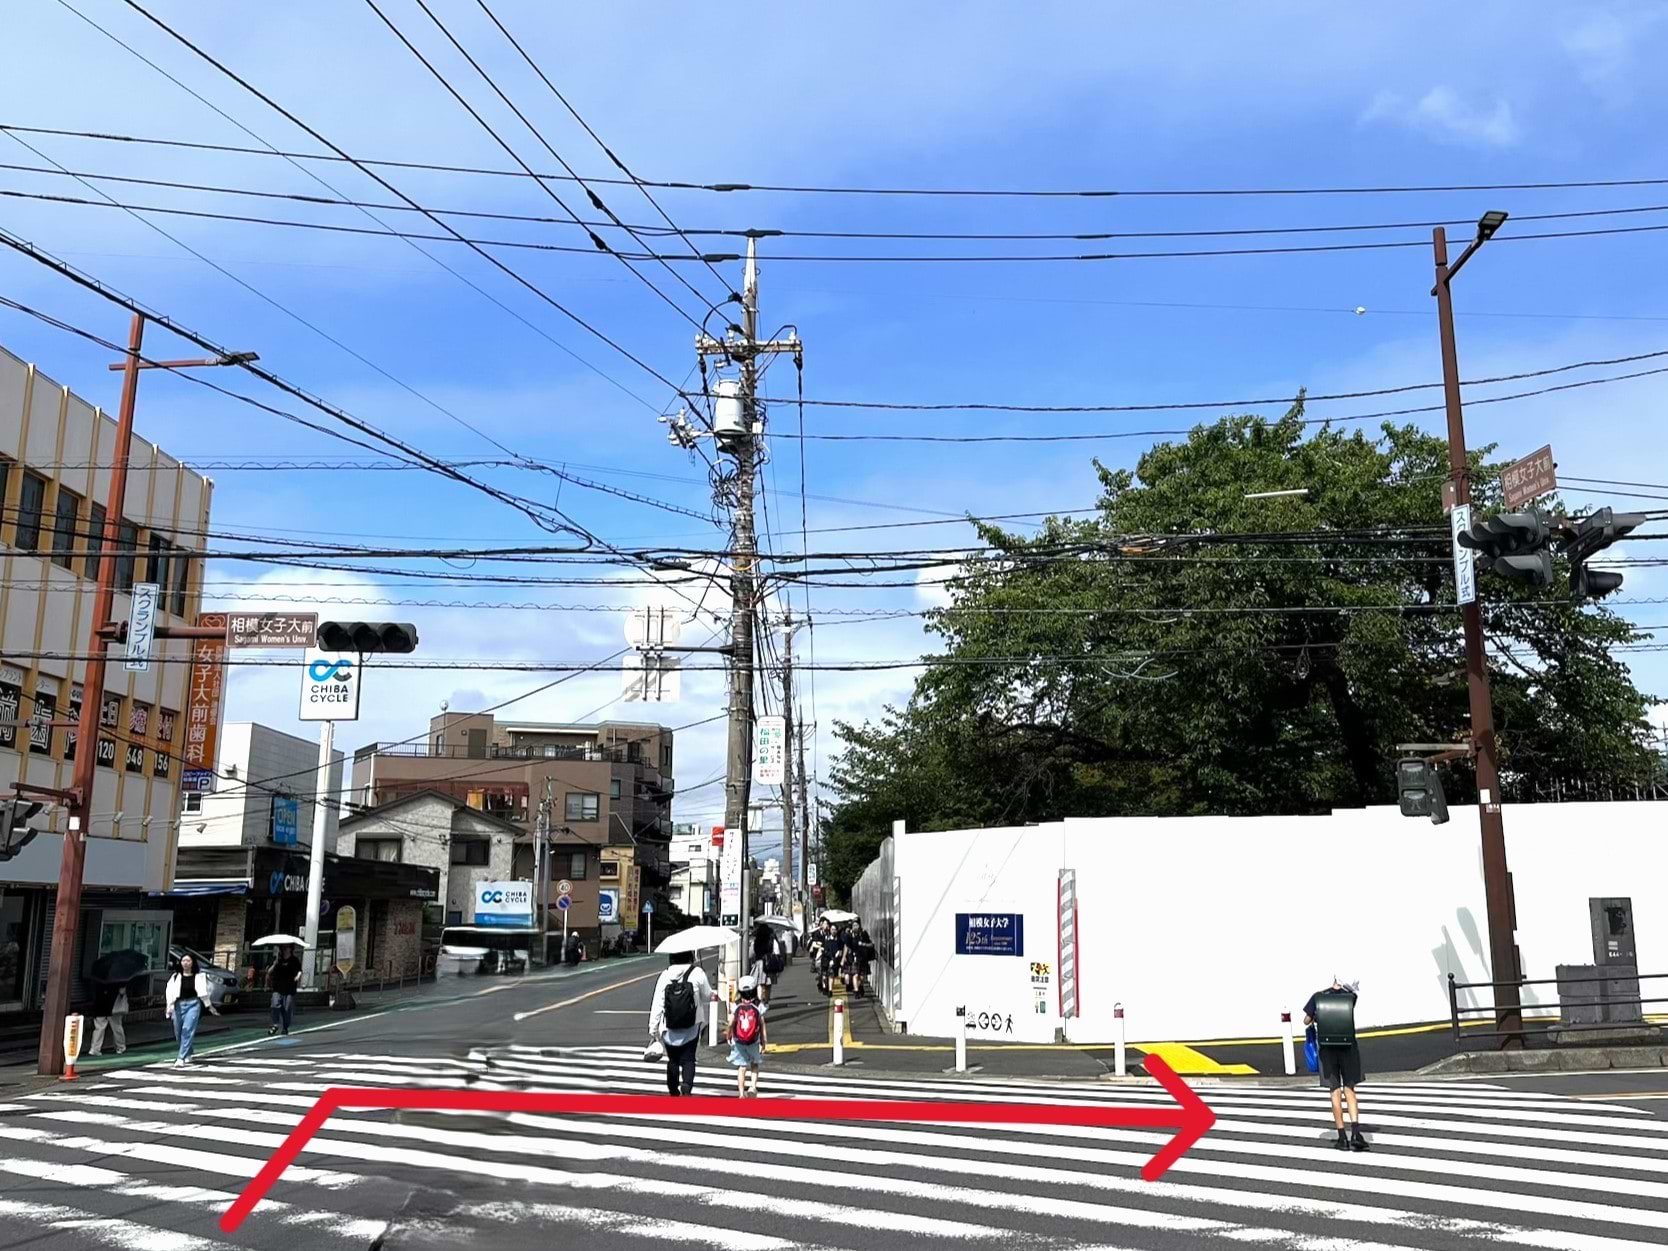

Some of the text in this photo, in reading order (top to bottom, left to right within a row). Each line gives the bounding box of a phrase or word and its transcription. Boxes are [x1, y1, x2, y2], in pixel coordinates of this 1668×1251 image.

[231, 617, 313, 633] 相模女子大前
[261, 634, 290, 643] Women's
[311, 684, 348, 693] CHIBA
[310, 694, 348, 703] CYCLE
[126, 748, 143, 766] 648
[284, 874, 304, 891] CHIBA
